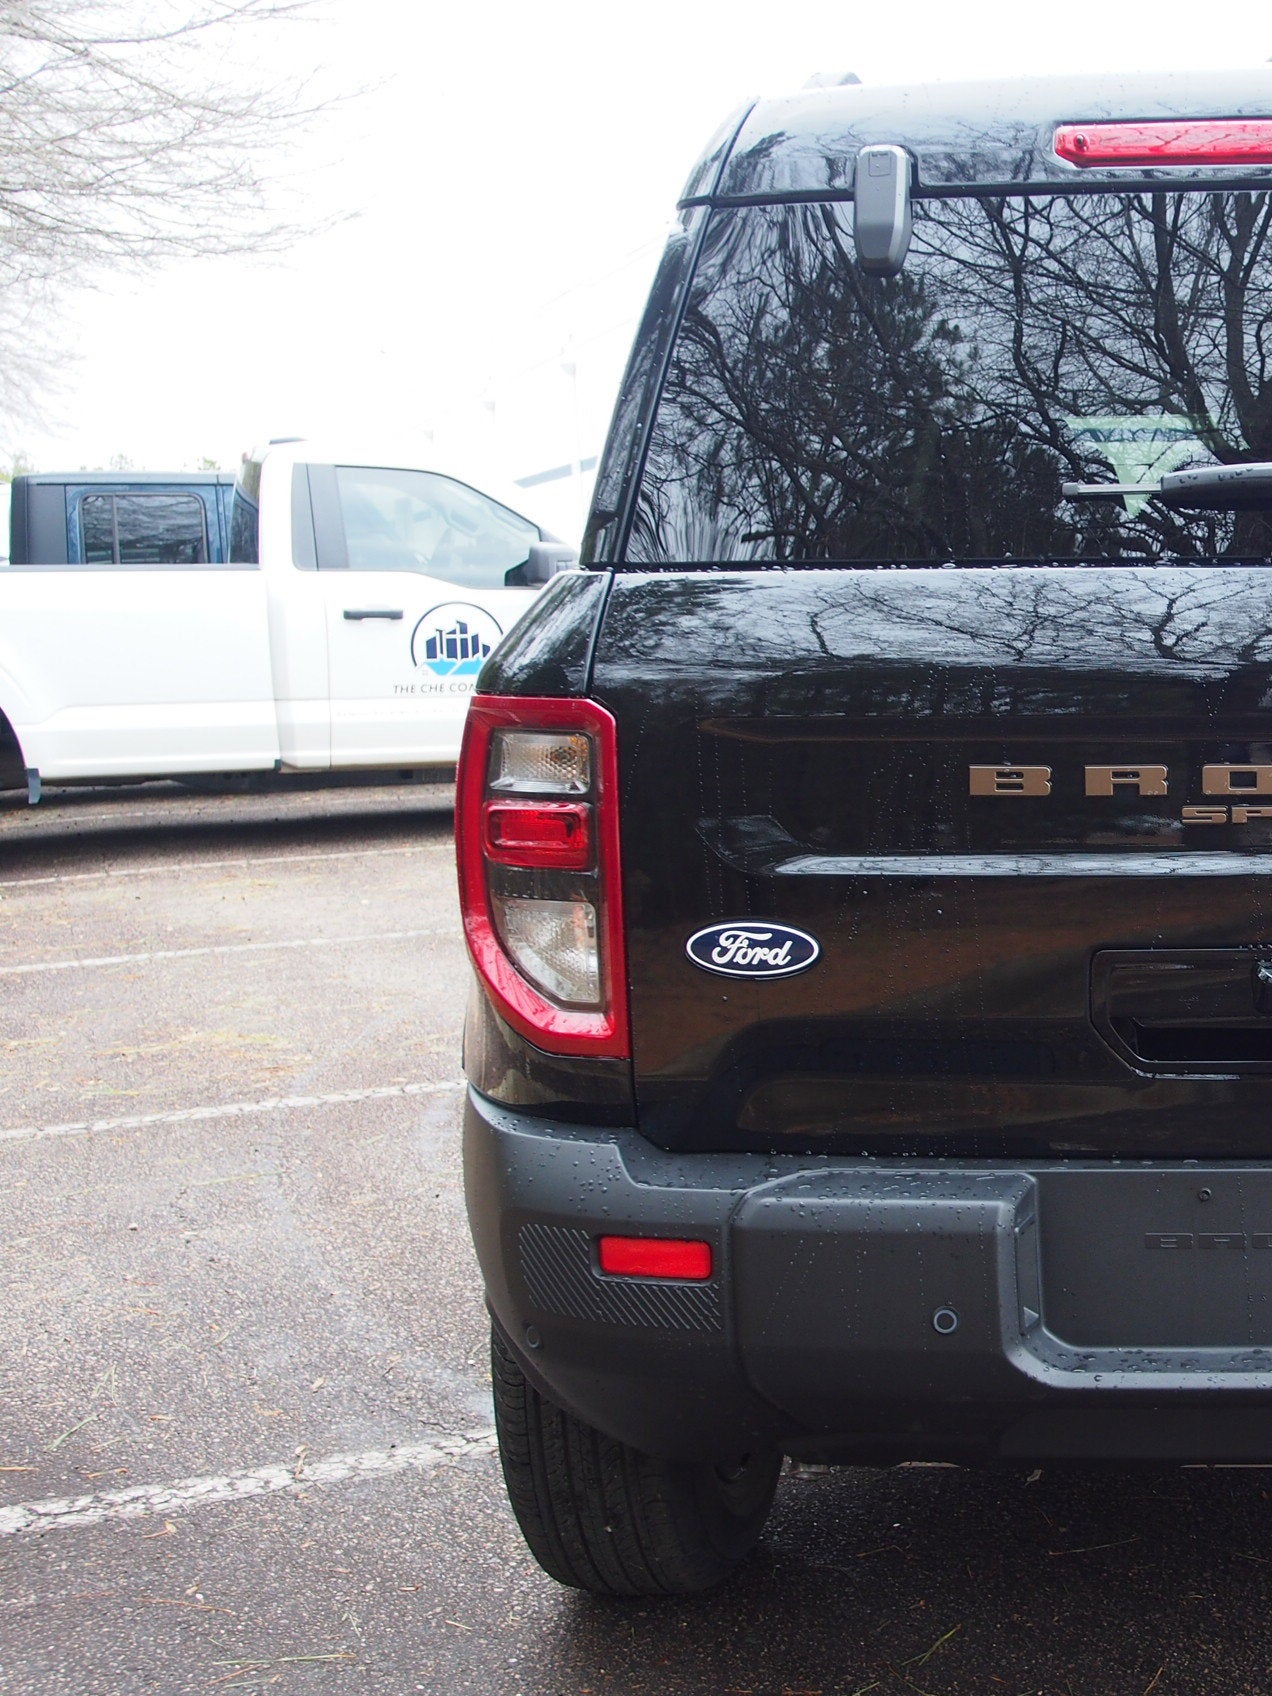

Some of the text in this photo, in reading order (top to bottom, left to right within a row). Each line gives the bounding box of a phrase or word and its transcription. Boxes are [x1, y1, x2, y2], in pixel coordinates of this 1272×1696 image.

[393, 684, 416, 694] THE
[420, 683, 445, 694] CHE
[711, 930, 794, 966] Ford
